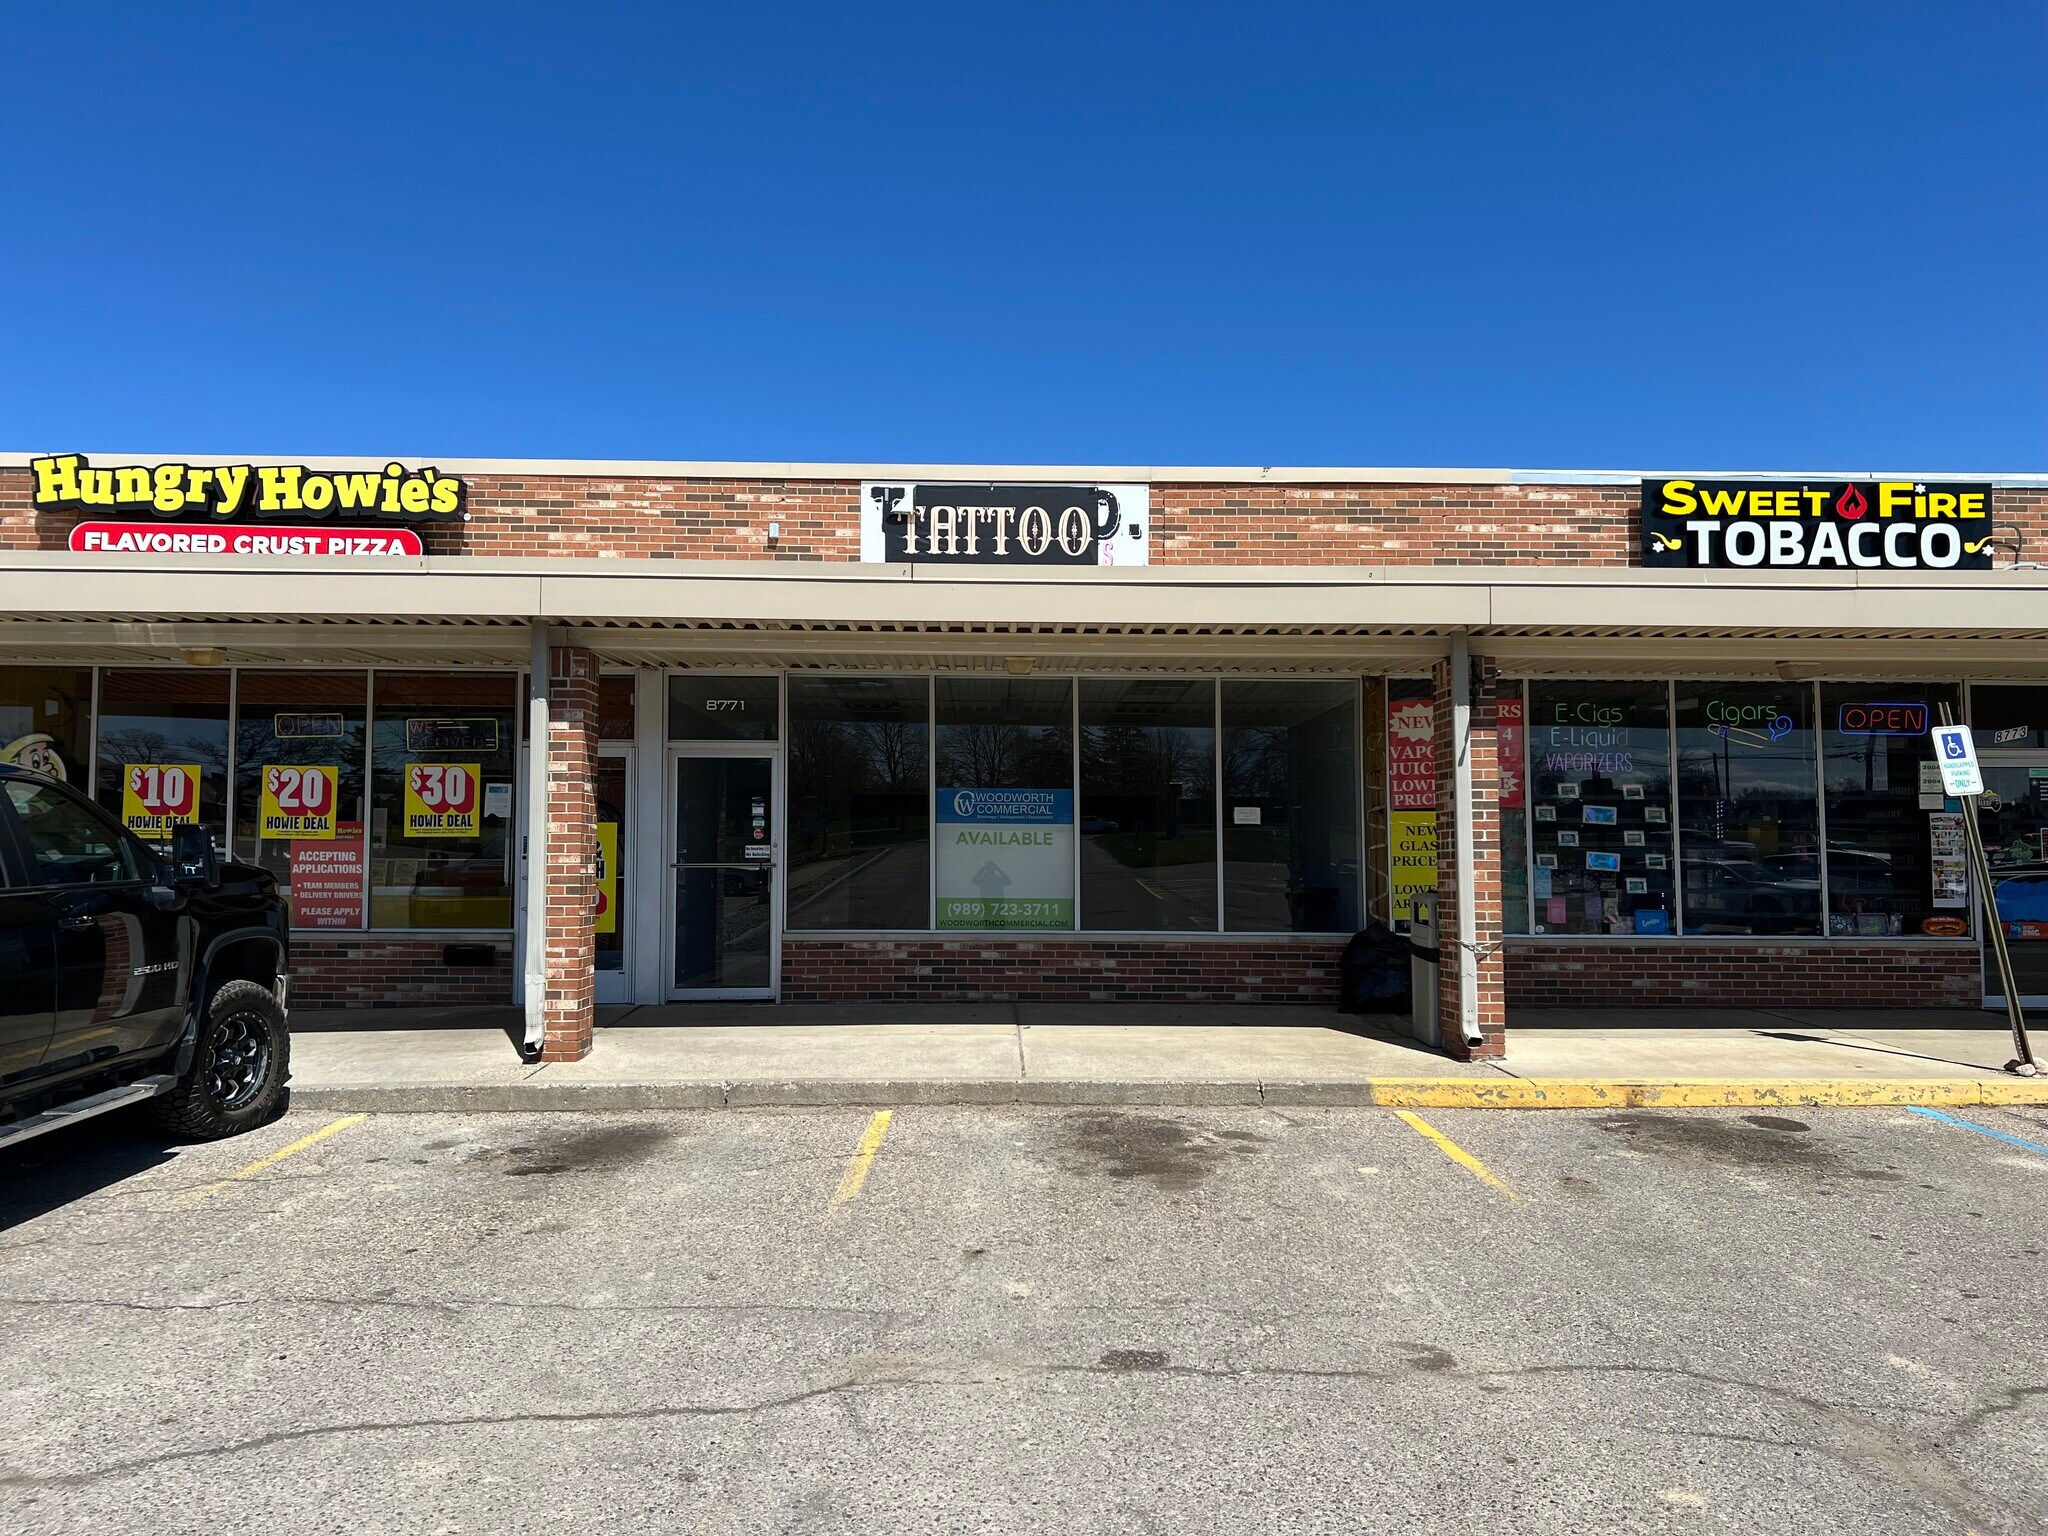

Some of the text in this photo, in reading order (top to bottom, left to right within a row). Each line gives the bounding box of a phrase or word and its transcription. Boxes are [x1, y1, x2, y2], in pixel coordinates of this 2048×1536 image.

[33, 456, 460, 514] Hungry Howie's
[1662, 480, 1830, 517] SWEET
[898, 505, 1095, 556] TATTOO
[84, 532, 404, 556] FLAVORED CRUST PIZZA
[1686, 520, 1962, 567] TOBACCO
[706, 699, 745, 711] 8771
[1555, 703, 1623, 728] E-Cigs
[1706, 700, 1777, 727] Cigars
[1846, 709, 1922, 730] OPEN
[278, 715, 340, 735] OPEN
[410, 721, 434, 733] WE
[1551, 727, 1629, 749] E-Liquid
[1996, 727, 2028, 742] 8773
[1389, 761, 1436, 776] JUIC
[1545, 752, 1633, 773] VAPORIZERS
[129, 767, 185, 807] $10
[267, 767, 324, 808] $20
[410, 766, 466, 806] $30
[1392, 779, 1436, 792] LOW
[975, 792, 1054, 803] WOODWORTH
[1393, 793, 1436, 806] PRIC
[976, 804, 1053, 815] COMMERCIAL
[128, 815, 162, 829] HOWIE
[266, 816, 330, 830] HOWIE DEAL
[410, 814, 473, 828] HOWIE DEAL
[955, 831, 1053, 846] AVAILABLE
[298, 851, 357, 862] ACCEPTING
[292, 864, 363, 874] APPLICATIONS
[300, 891, 363, 899] DELIVERY DRIVERS
[301, 907, 360, 915] PLEASE APPLY
[947, 903, 1059, 917] (989) 723-3711
[317, 917, 347, 926] WITHIN
[939, 919, 1068, 927] WOODWORTHCOMMERCIAL.COM
[133, 961, 179, 976] 2500 HD
